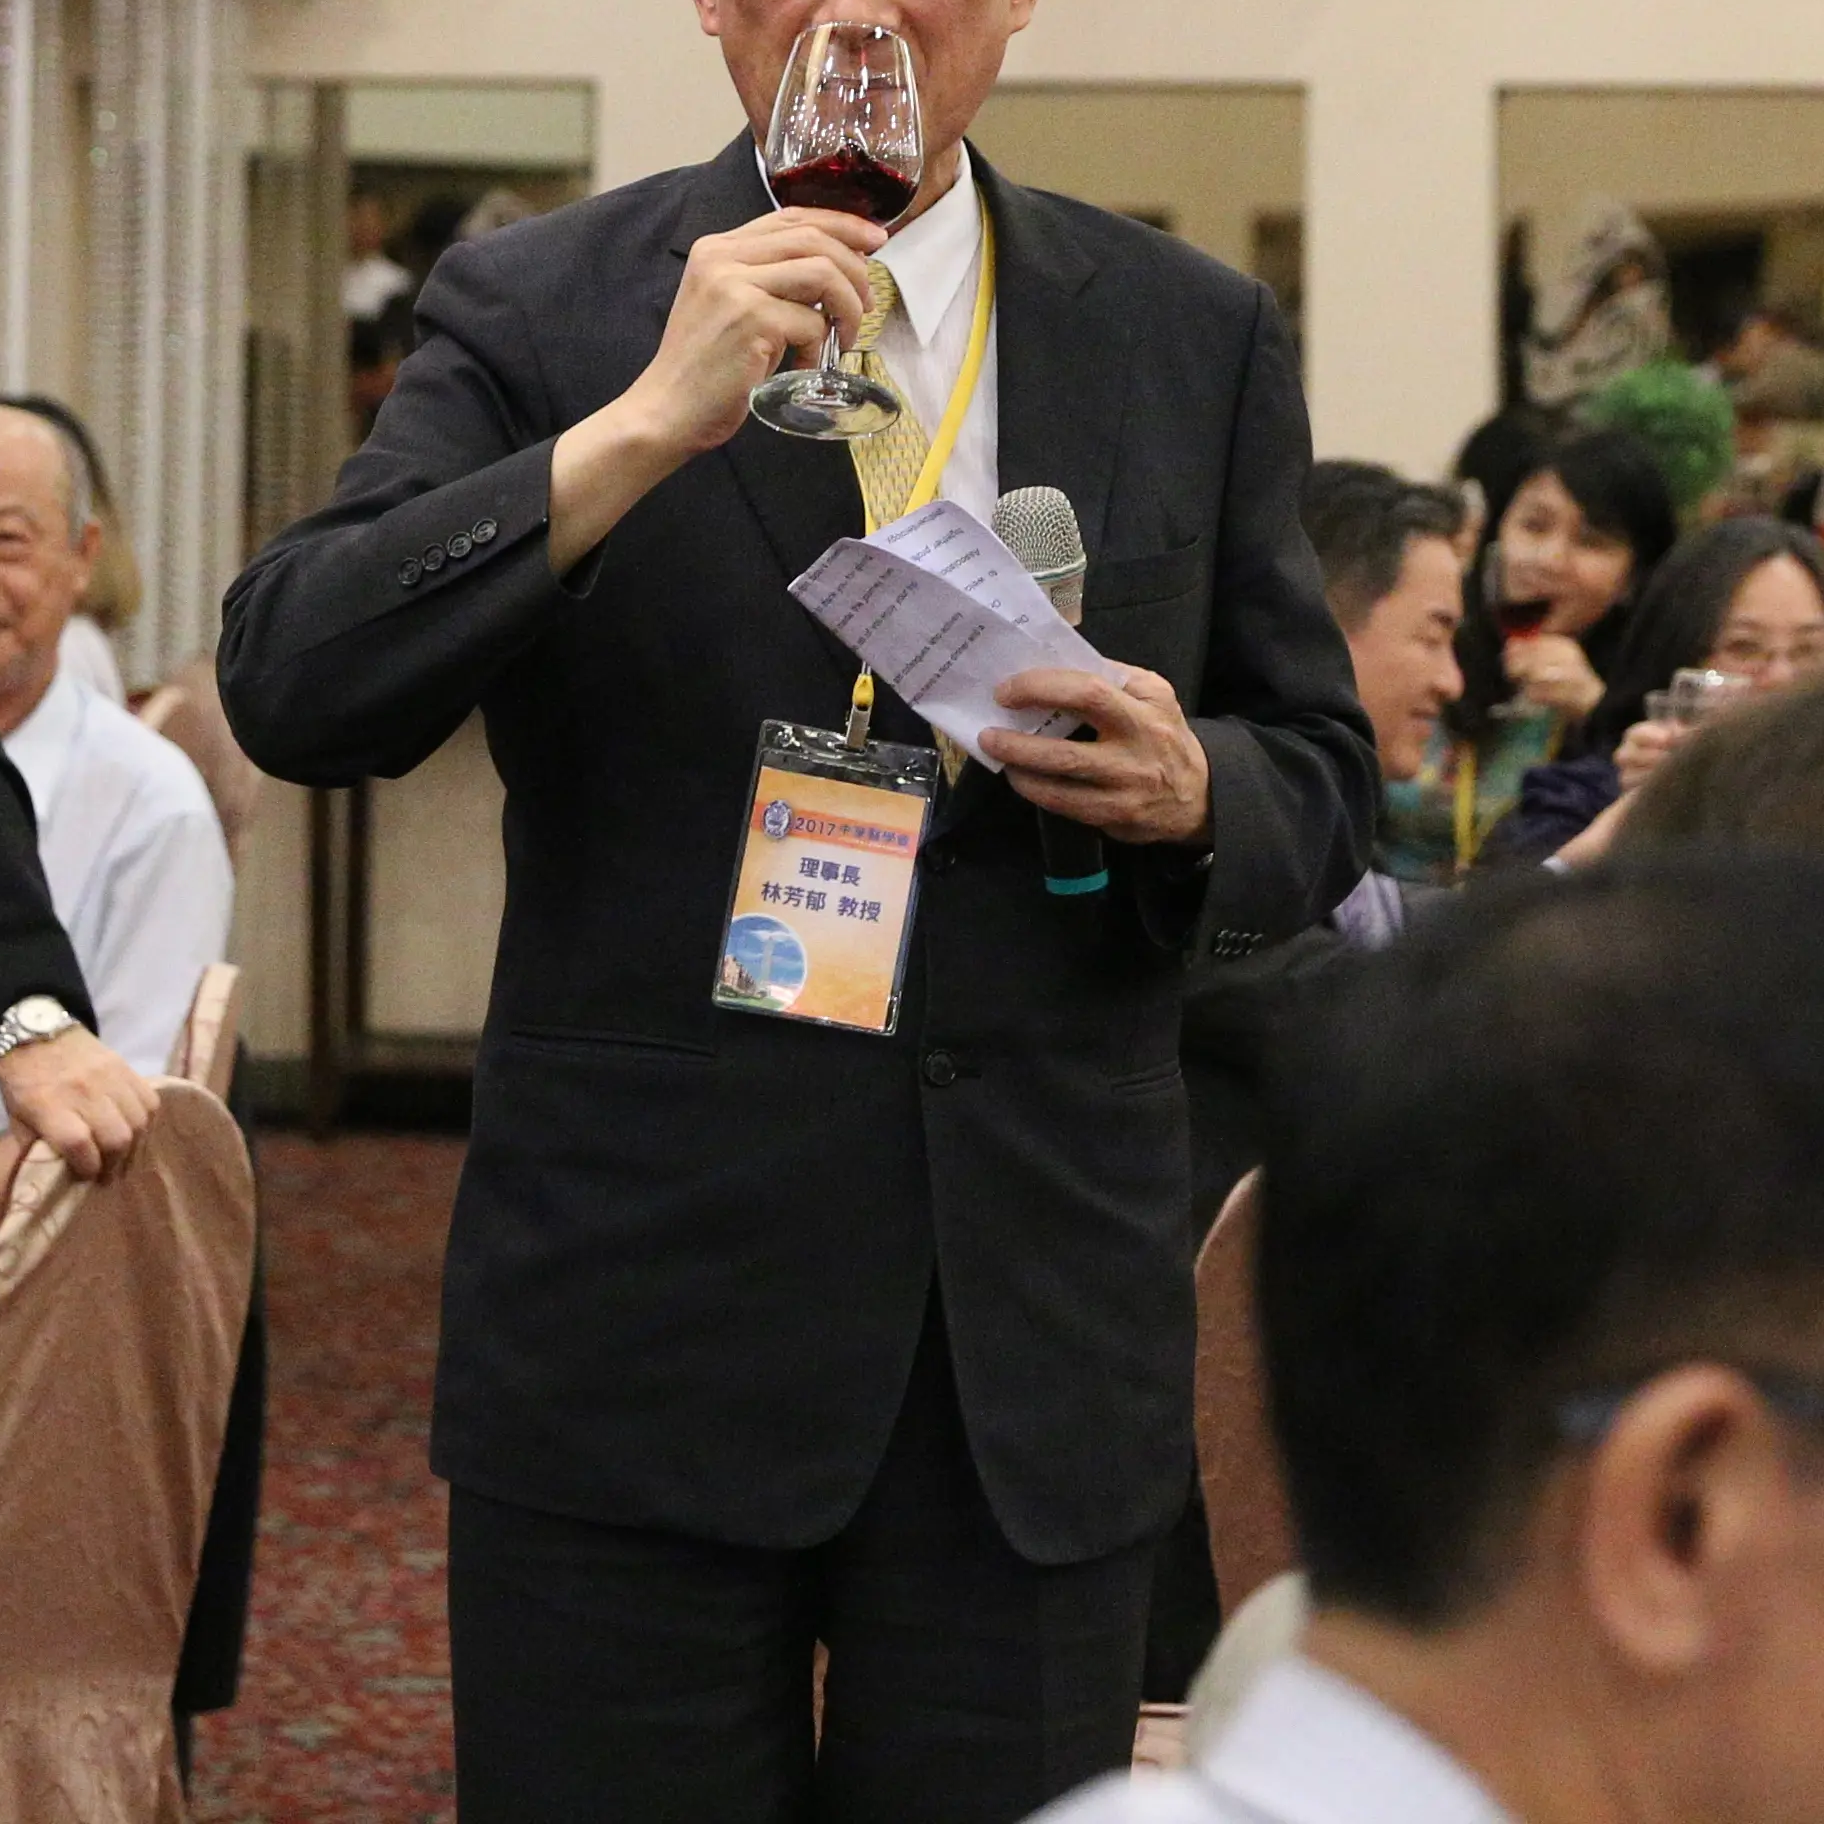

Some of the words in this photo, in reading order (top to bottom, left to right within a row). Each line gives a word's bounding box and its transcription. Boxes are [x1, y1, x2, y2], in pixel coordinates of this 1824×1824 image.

[795, 817, 836, 836] 2017
[799, 857, 861, 886] 理事長
[761, 880, 827, 911] 林芳郁
[837, 895, 882, 922] 教授
